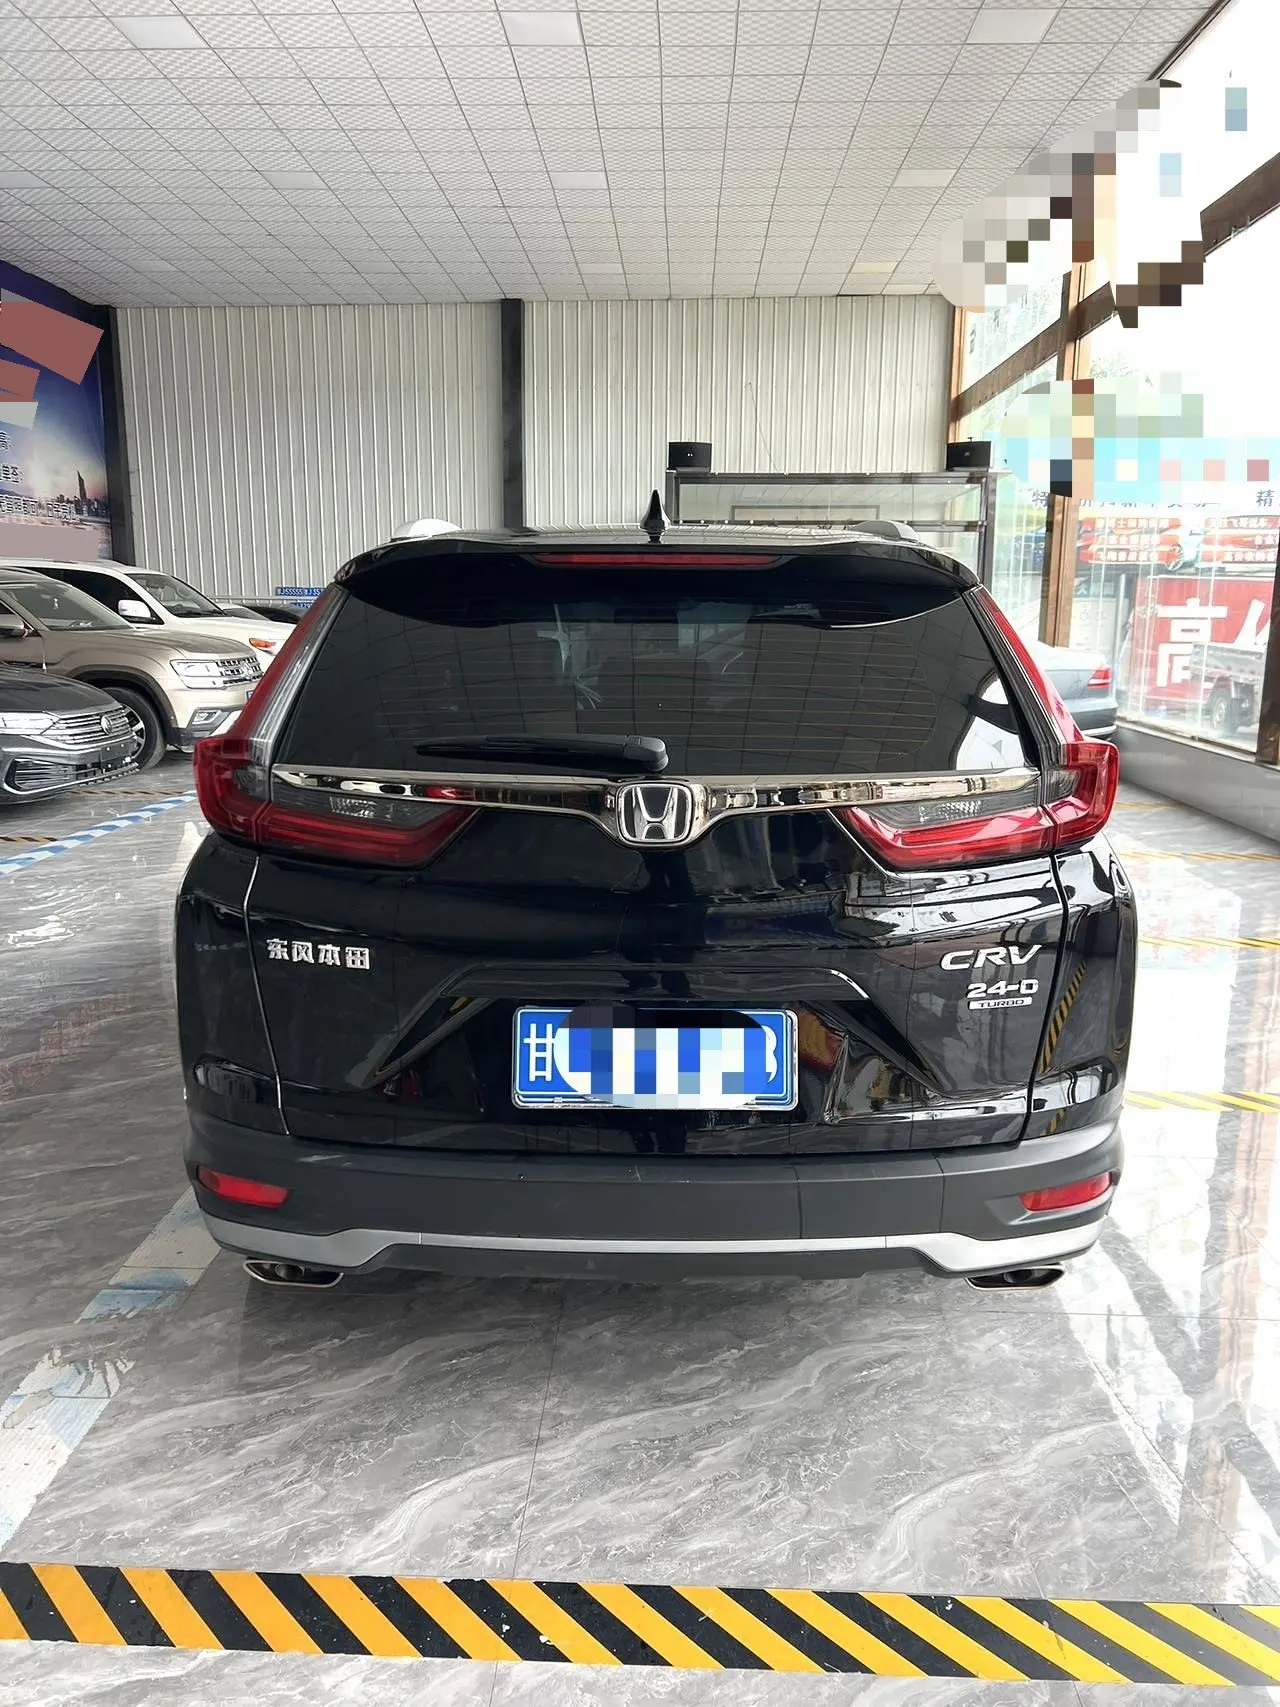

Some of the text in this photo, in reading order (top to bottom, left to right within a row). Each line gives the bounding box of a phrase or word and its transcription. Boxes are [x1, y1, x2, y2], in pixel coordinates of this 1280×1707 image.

[266, 938, 370, 970] 东风本田
[940, 944, 1042, 971] CRV
[978, 999, 1025, 1008] TURBO
